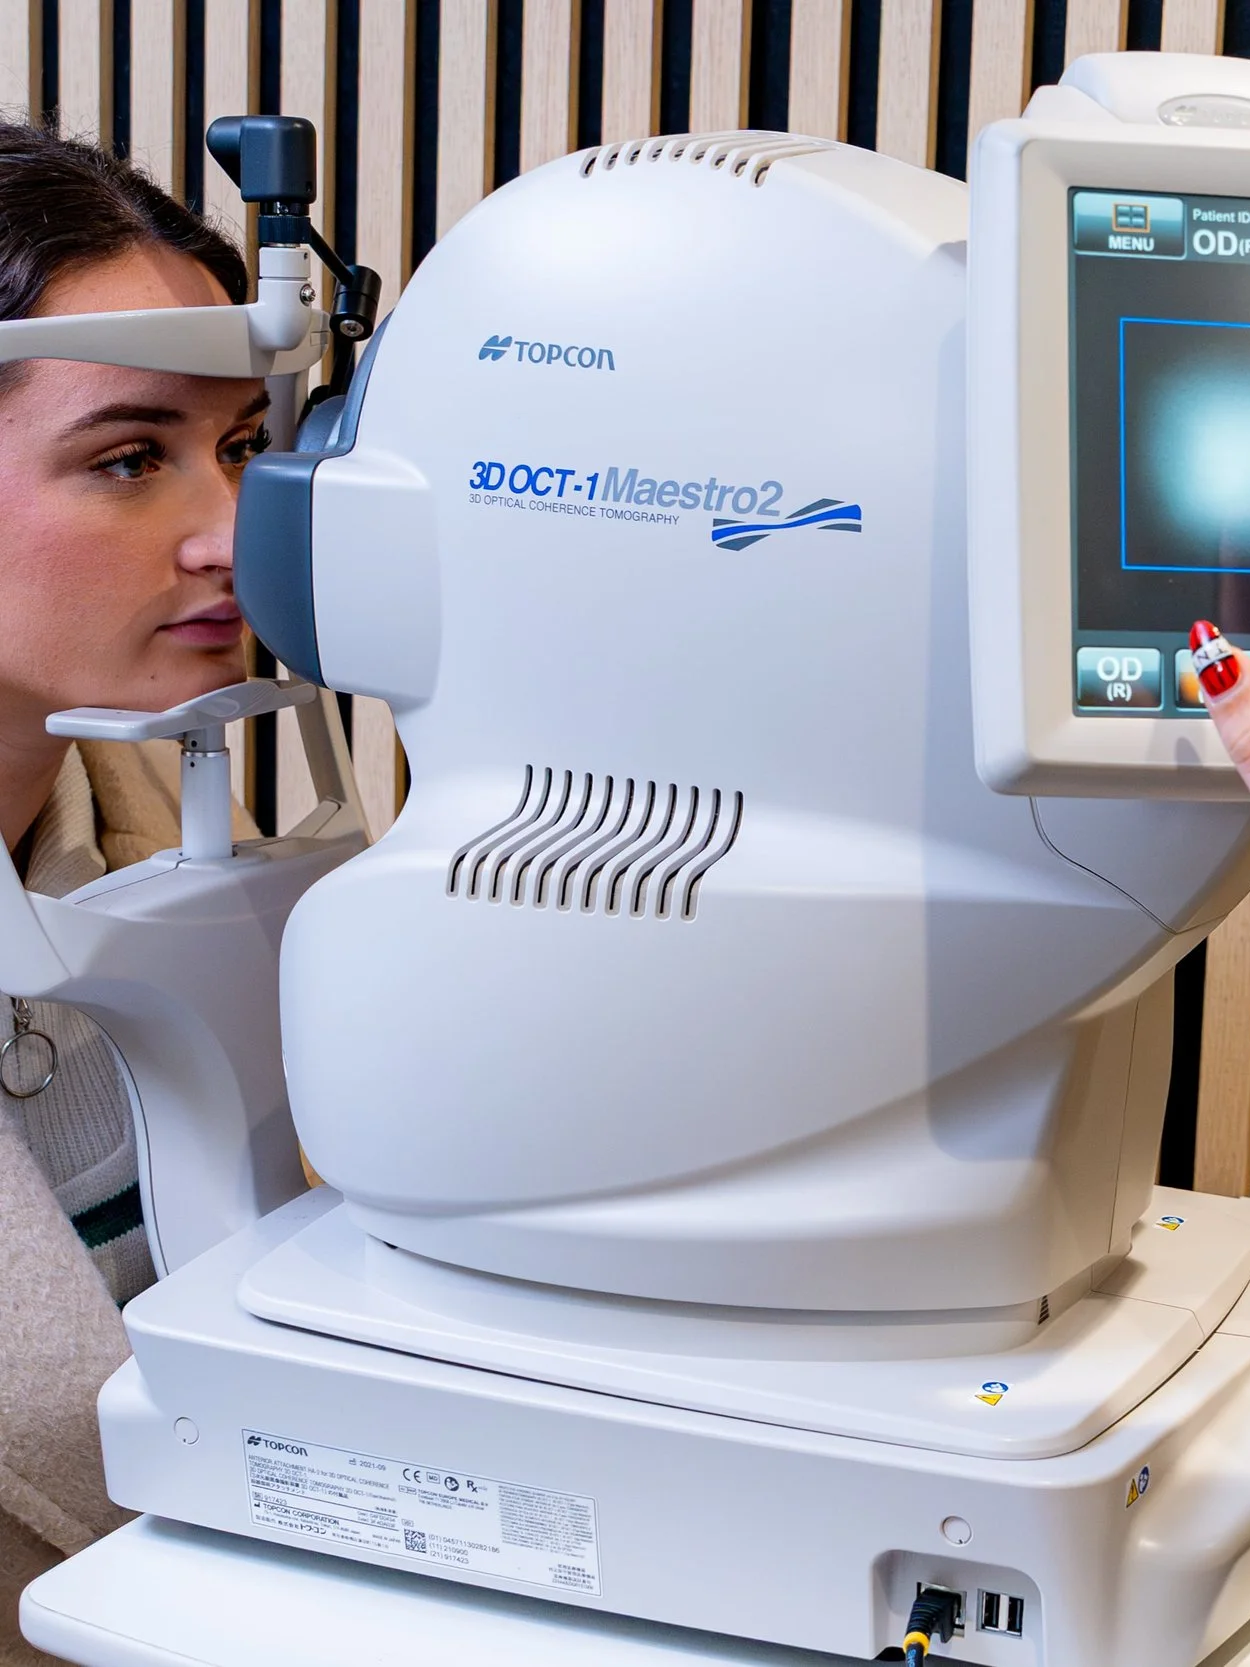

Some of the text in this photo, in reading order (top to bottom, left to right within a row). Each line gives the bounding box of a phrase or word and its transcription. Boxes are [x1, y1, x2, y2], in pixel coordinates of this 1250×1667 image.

[1192, 208, 1236, 223] Patient
[1108, 235, 1155, 252] MENU
[514, 340, 616, 371] TOPCON
[469, 461, 505, 491] 3D
[600, 466, 784, 517] Maestro2
[469, 493, 680, 526] 3D OPTICAL COHERENCE TOMOGRAPHY
[1097, 656, 1142, 682] OD
[1106, 684, 1132, 702] (R)
[262, 1438, 309, 1457] TOPCON
[402, 1468, 421, 1484] CE
[263, 1503, 290, 1515] TOPCON
